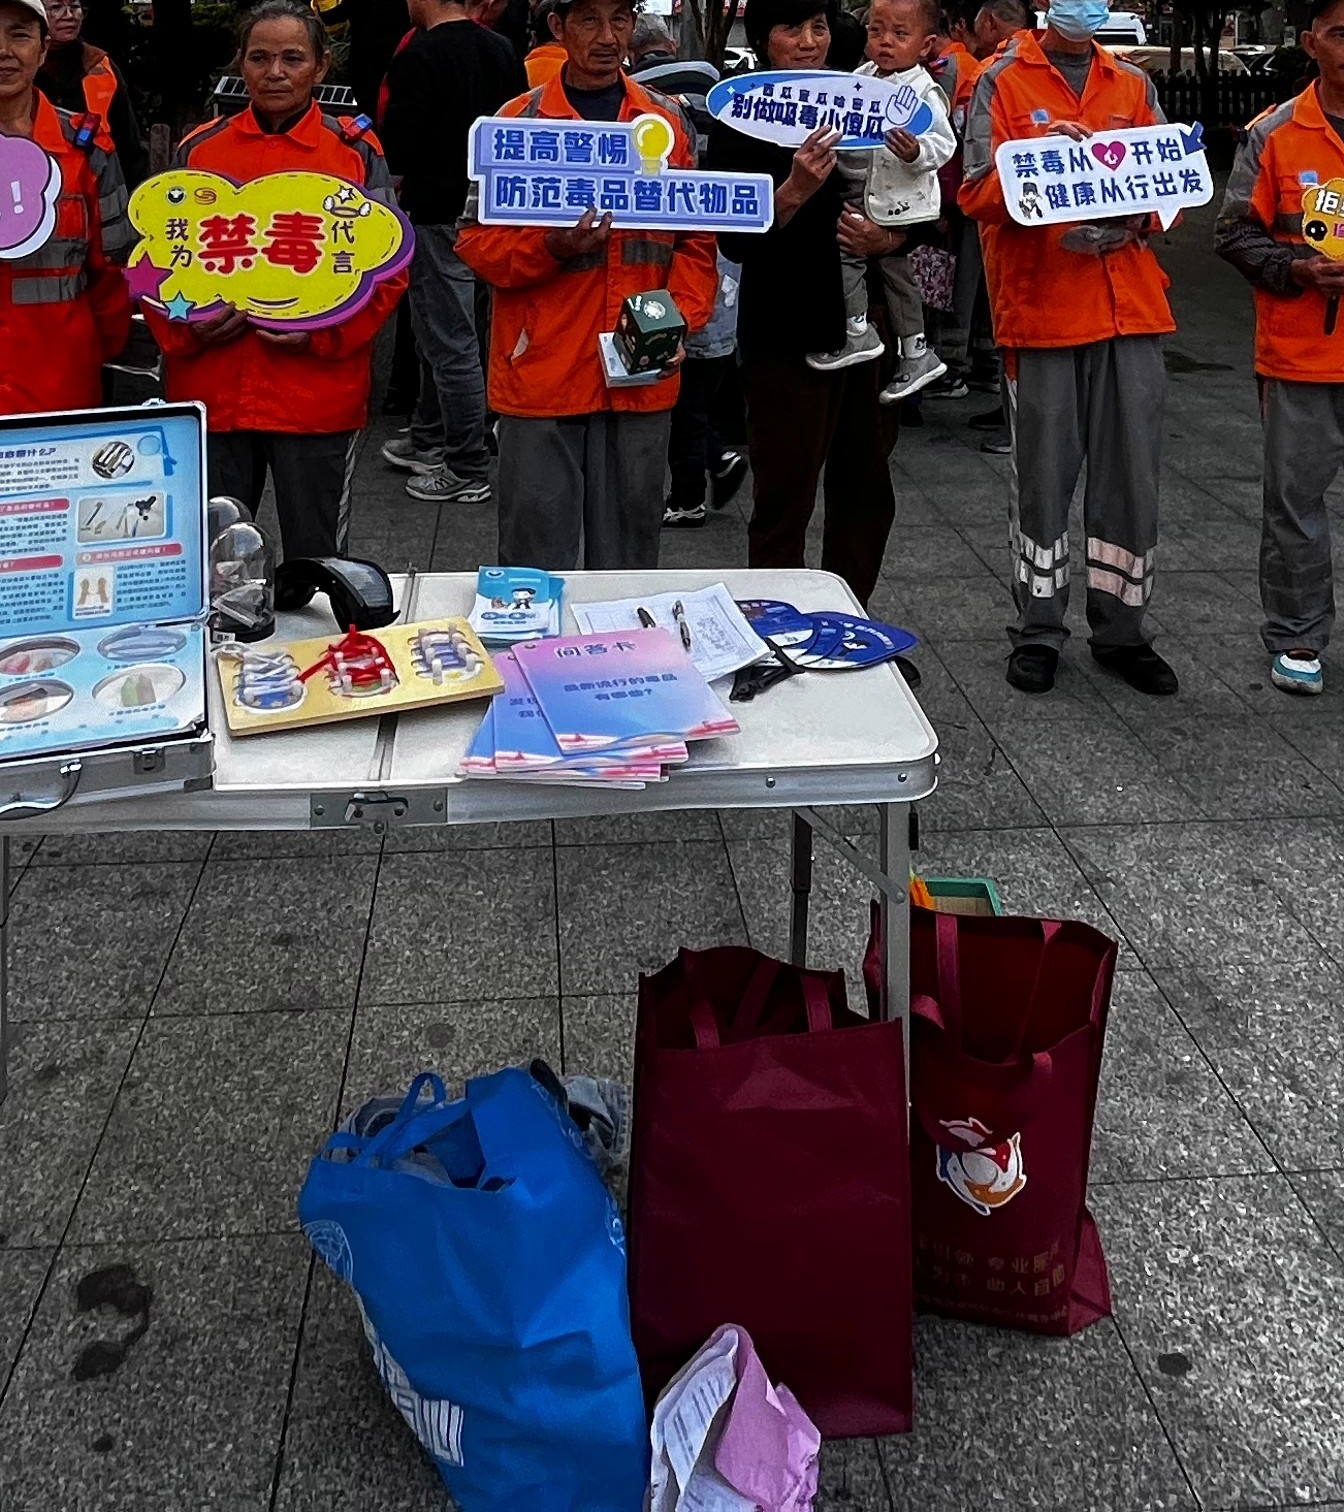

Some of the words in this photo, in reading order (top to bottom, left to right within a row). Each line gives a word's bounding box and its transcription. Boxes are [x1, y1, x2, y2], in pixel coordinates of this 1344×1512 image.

[731, 93, 886, 141] 别做吸毒小傻瓜
[494, 128, 628, 165] 提高警惕
[495, 174, 760, 216] 防范毒品替代物品
[1044, 168, 1205, 210] 健康从行出发
[197, 211, 326, 275] 禁毒
[556, 640, 638, 658] 问答卡
